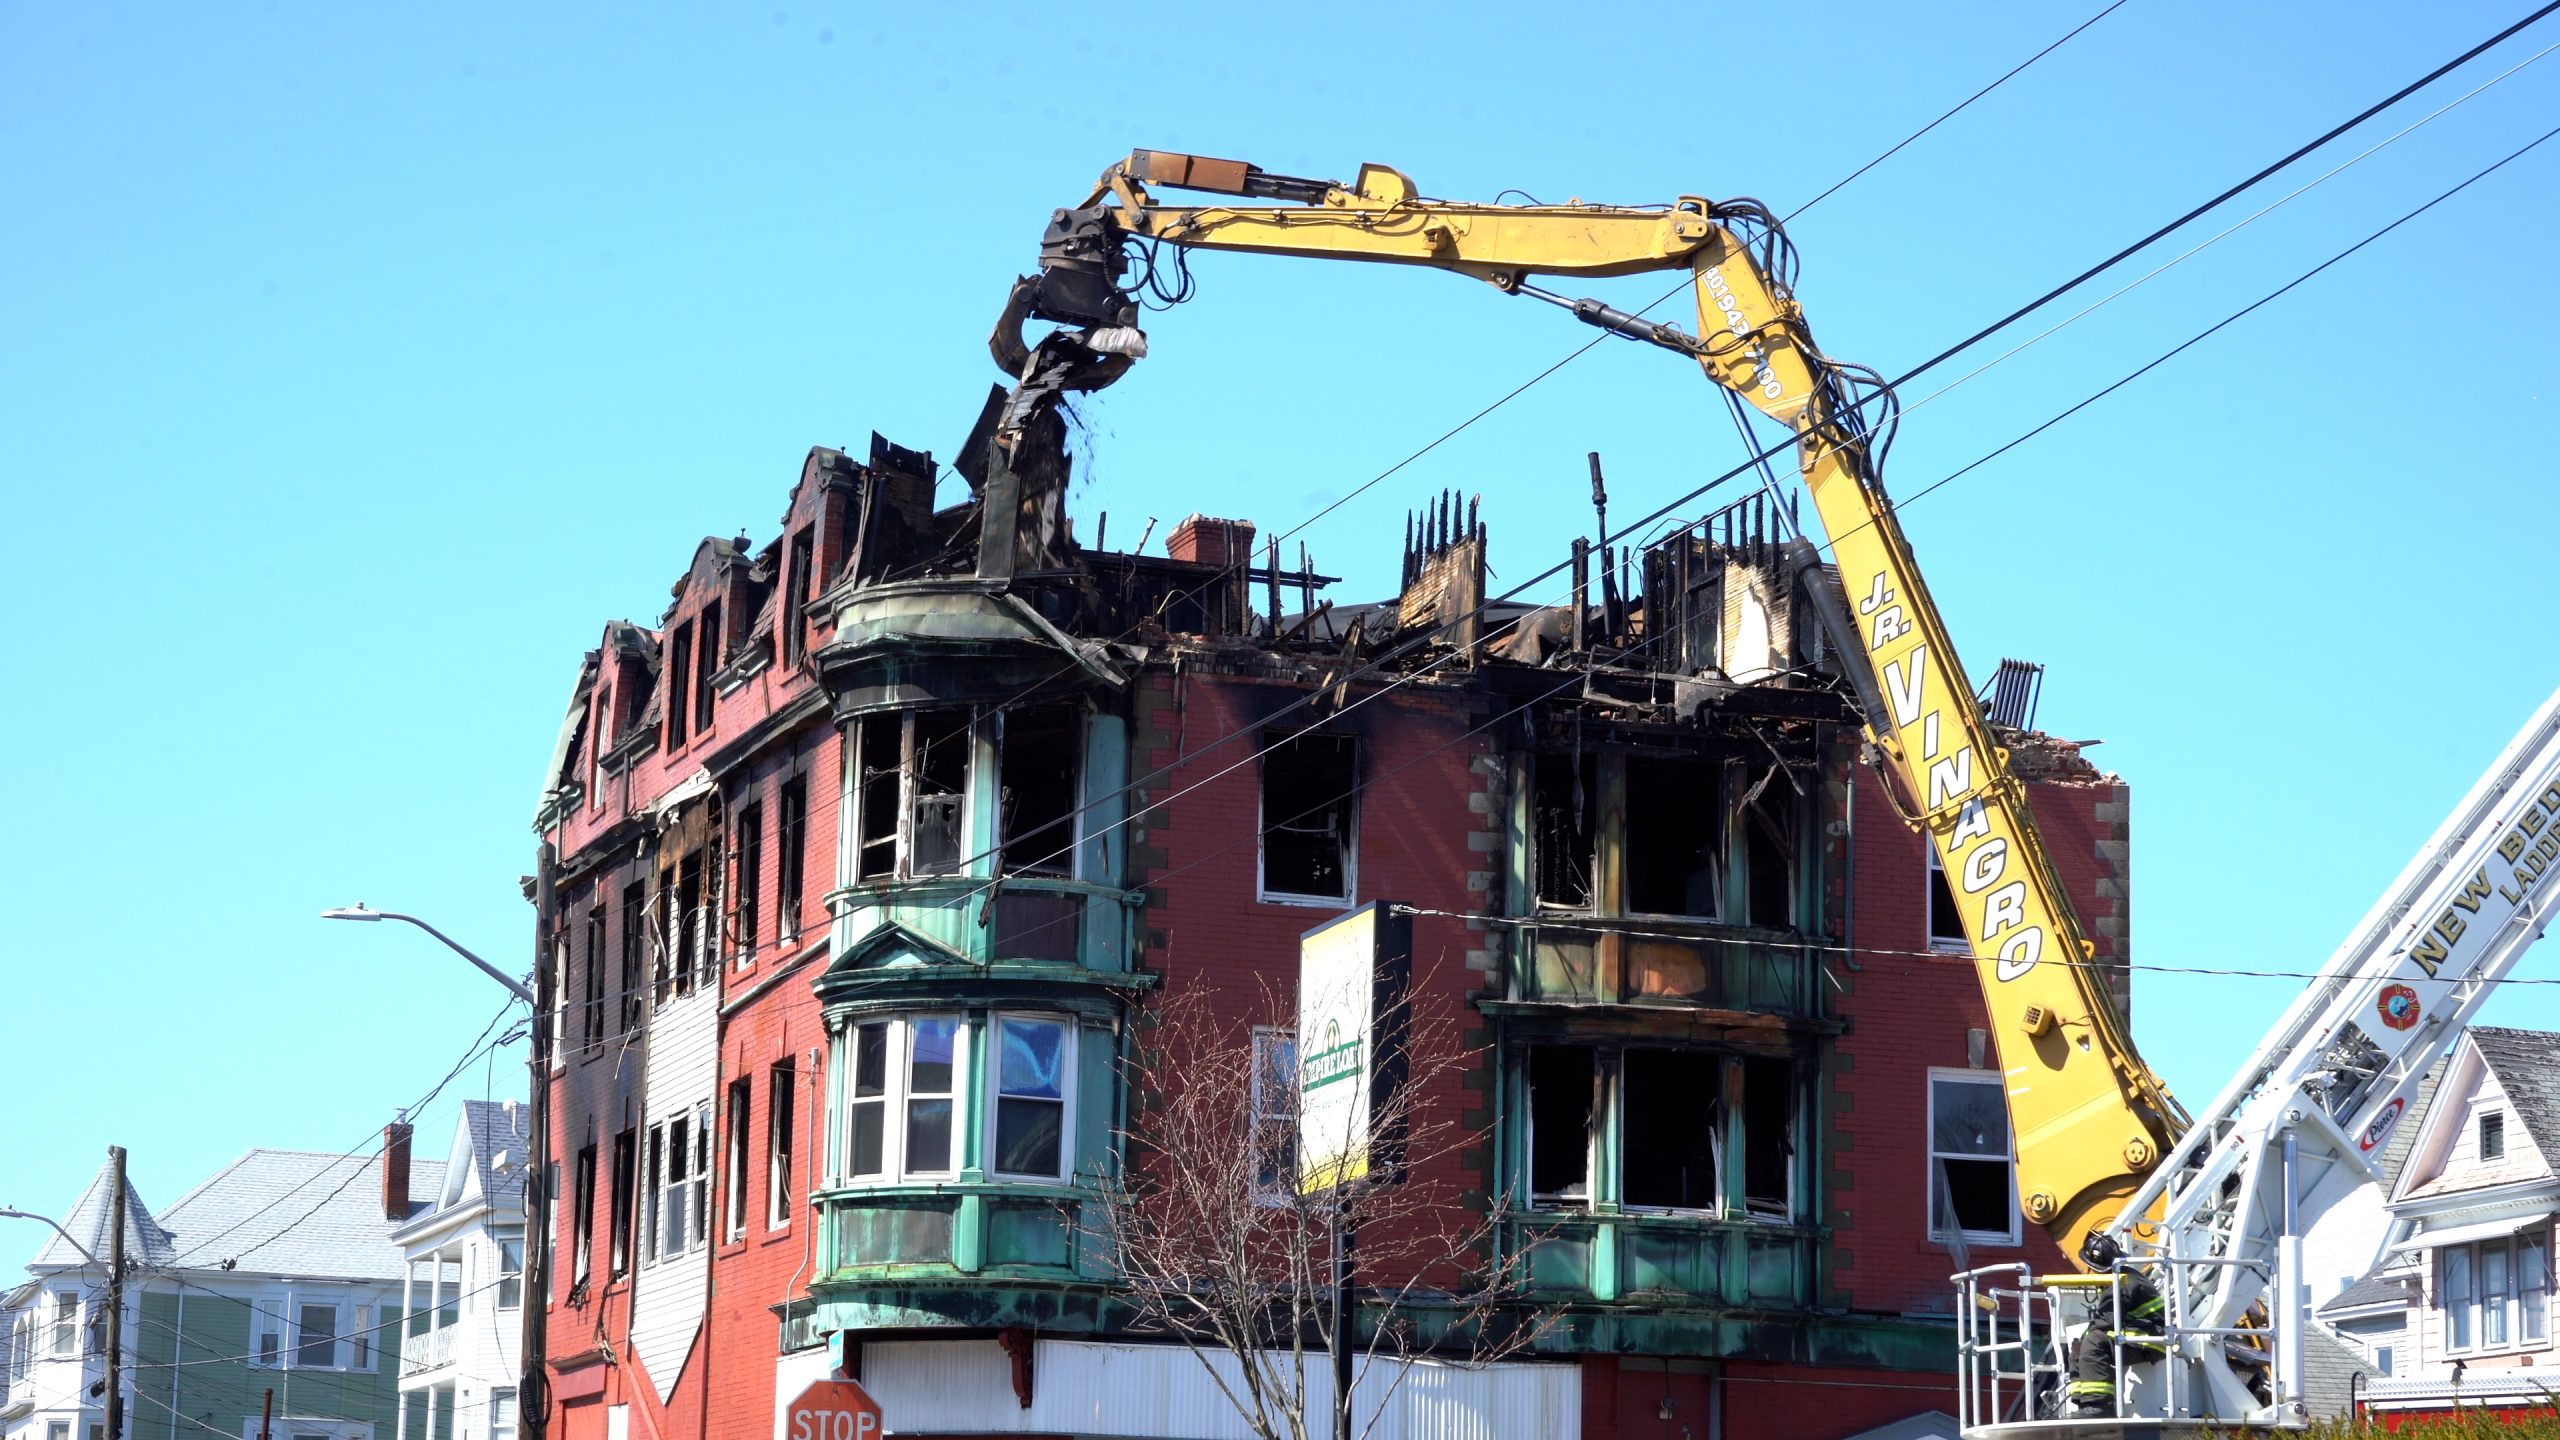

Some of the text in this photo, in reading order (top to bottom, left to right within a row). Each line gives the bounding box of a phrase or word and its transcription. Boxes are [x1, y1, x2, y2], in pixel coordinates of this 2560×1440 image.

[1883, 643, 2043, 983] VINAGRO
[2410, 780, 2560, 978] NEW BED
[2370, 1109, 2394, 1143] Pierce
[793, 1409, 876, 1440] STOP
